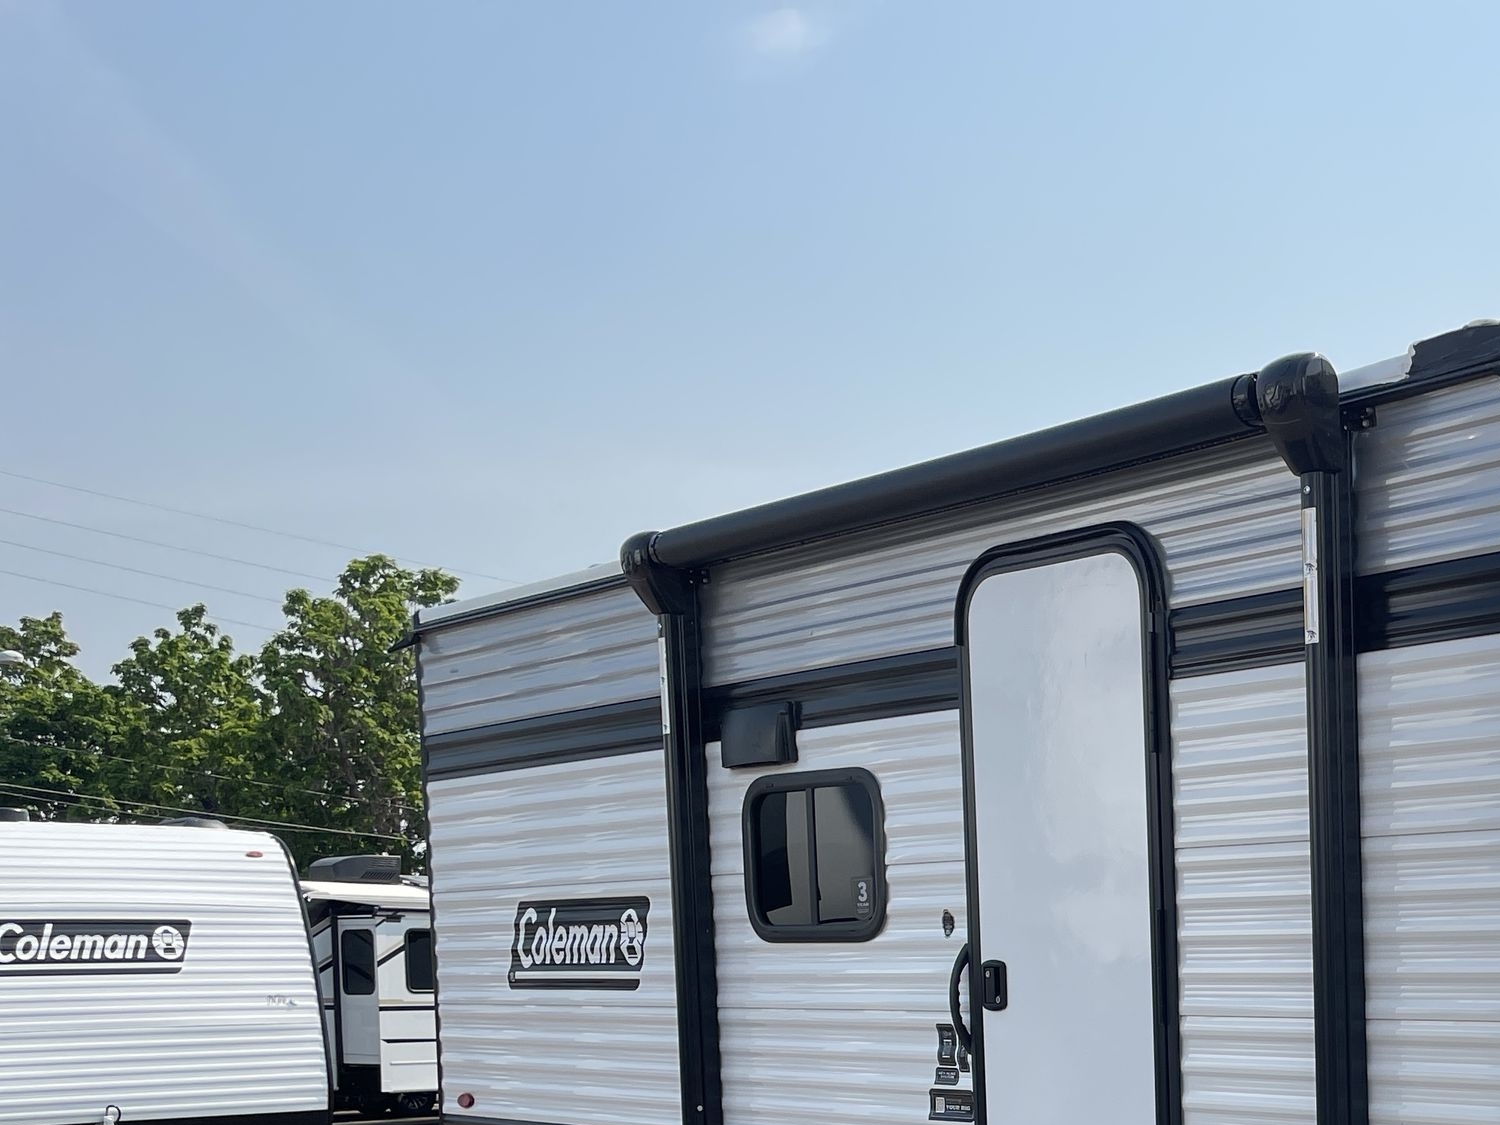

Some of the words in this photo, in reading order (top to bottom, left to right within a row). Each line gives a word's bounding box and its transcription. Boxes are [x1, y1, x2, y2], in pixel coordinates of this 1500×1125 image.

[857, 881, 868, 902] 3
[0, 922, 149, 964] Coleman
[517, 907, 618, 968] Coleman
